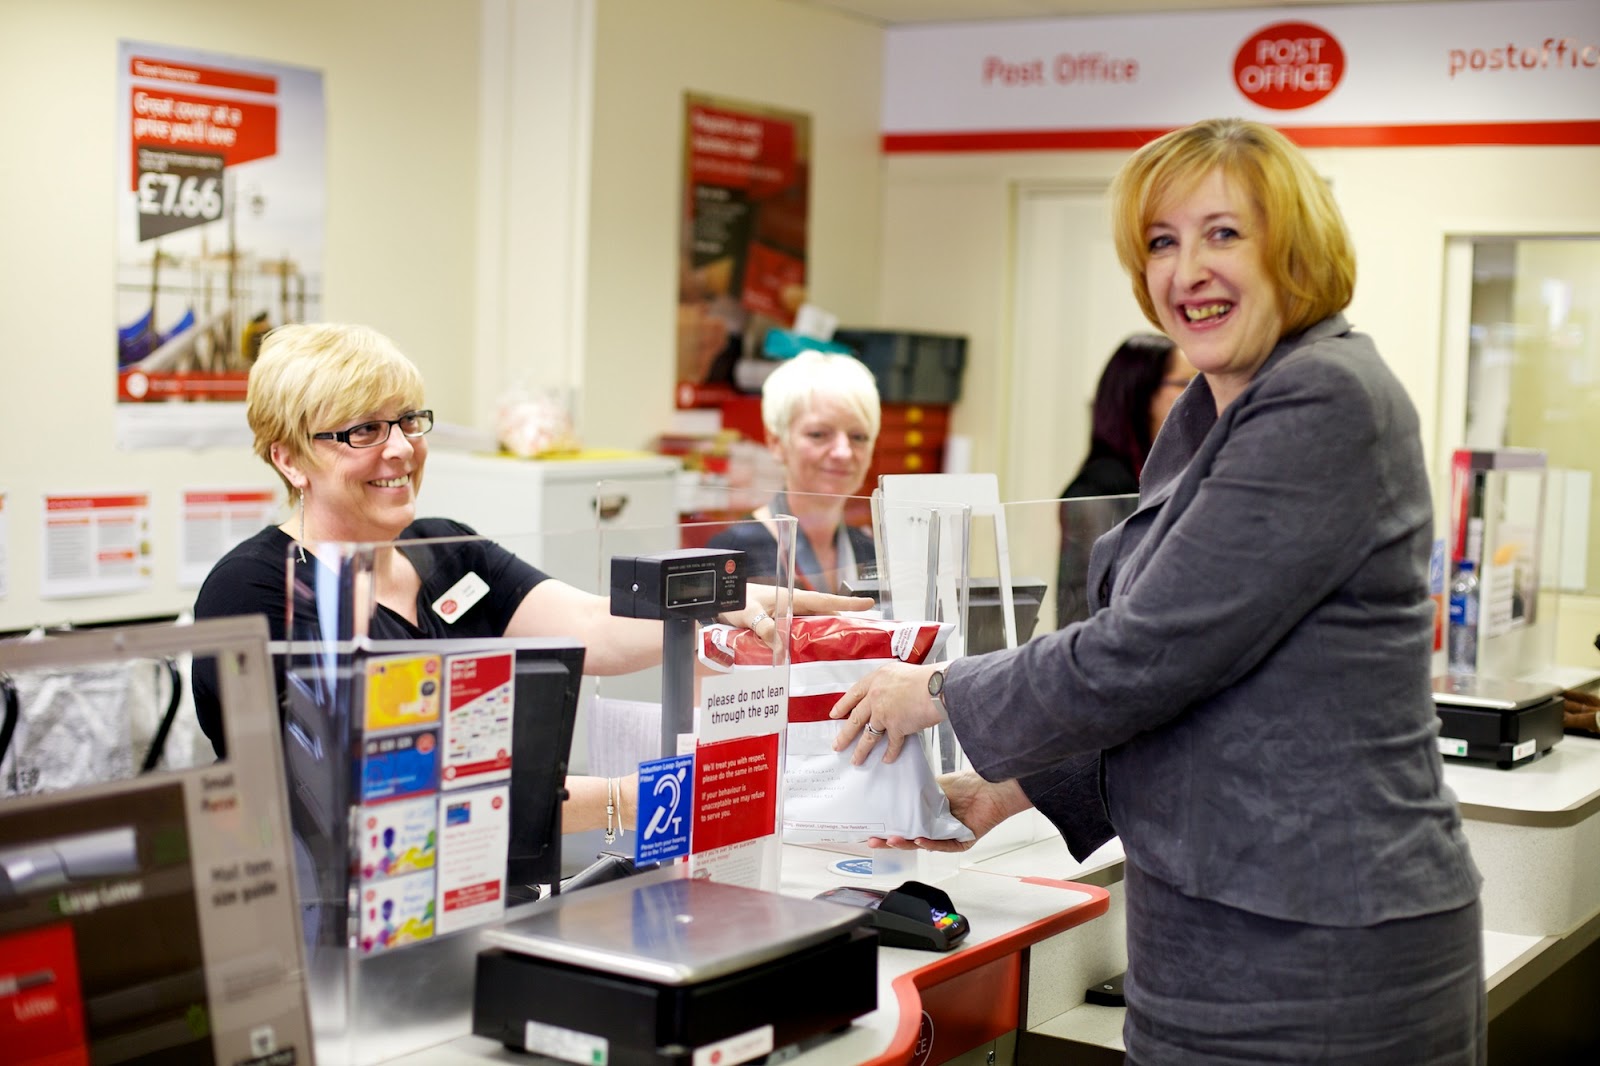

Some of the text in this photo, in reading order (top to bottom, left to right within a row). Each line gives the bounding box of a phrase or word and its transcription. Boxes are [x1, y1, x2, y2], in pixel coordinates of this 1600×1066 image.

[1256, 38, 1325, 65] POST
[1449, 37, 1600, 79] postoffic
[983, 52, 1139, 86] Post Office
[1239, 63, 1333, 93] OFFICE
[134, 92, 173, 116] Great
[175, 101, 211, 121] cover
[134, 117, 170, 139] price
[207, 125, 237, 146] love
[139, 172, 221, 219] £7.66
[707, 686, 784, 710] please do not lean
[712, 704, 779, 724] through the gap
[663, 763, 674, 771] Loop
[675, 760, 691, 768] System
[702, 763, 714, 772] We'll
[715, 761, 727, 770] treat
[728, 760, 736, 769] you
[737, 756, 747, 765] with
[202, 775, 234, 792] Small
[702, 774, 717, 784] please
[719, 772, 725, 780] do
[735, 768, 747, 777] same
[701, 798, 732, 811] unacceptable
[740, 794, 750, 802] may
[751, 791, 765, 800] refuse
[706, 791, 717, 801] your
[718, 785, 741, 797] behaviour
[672, 816, 682, 835] T
[707, 812, 720, 821] serve
[244, 882, 277, 904] guide
